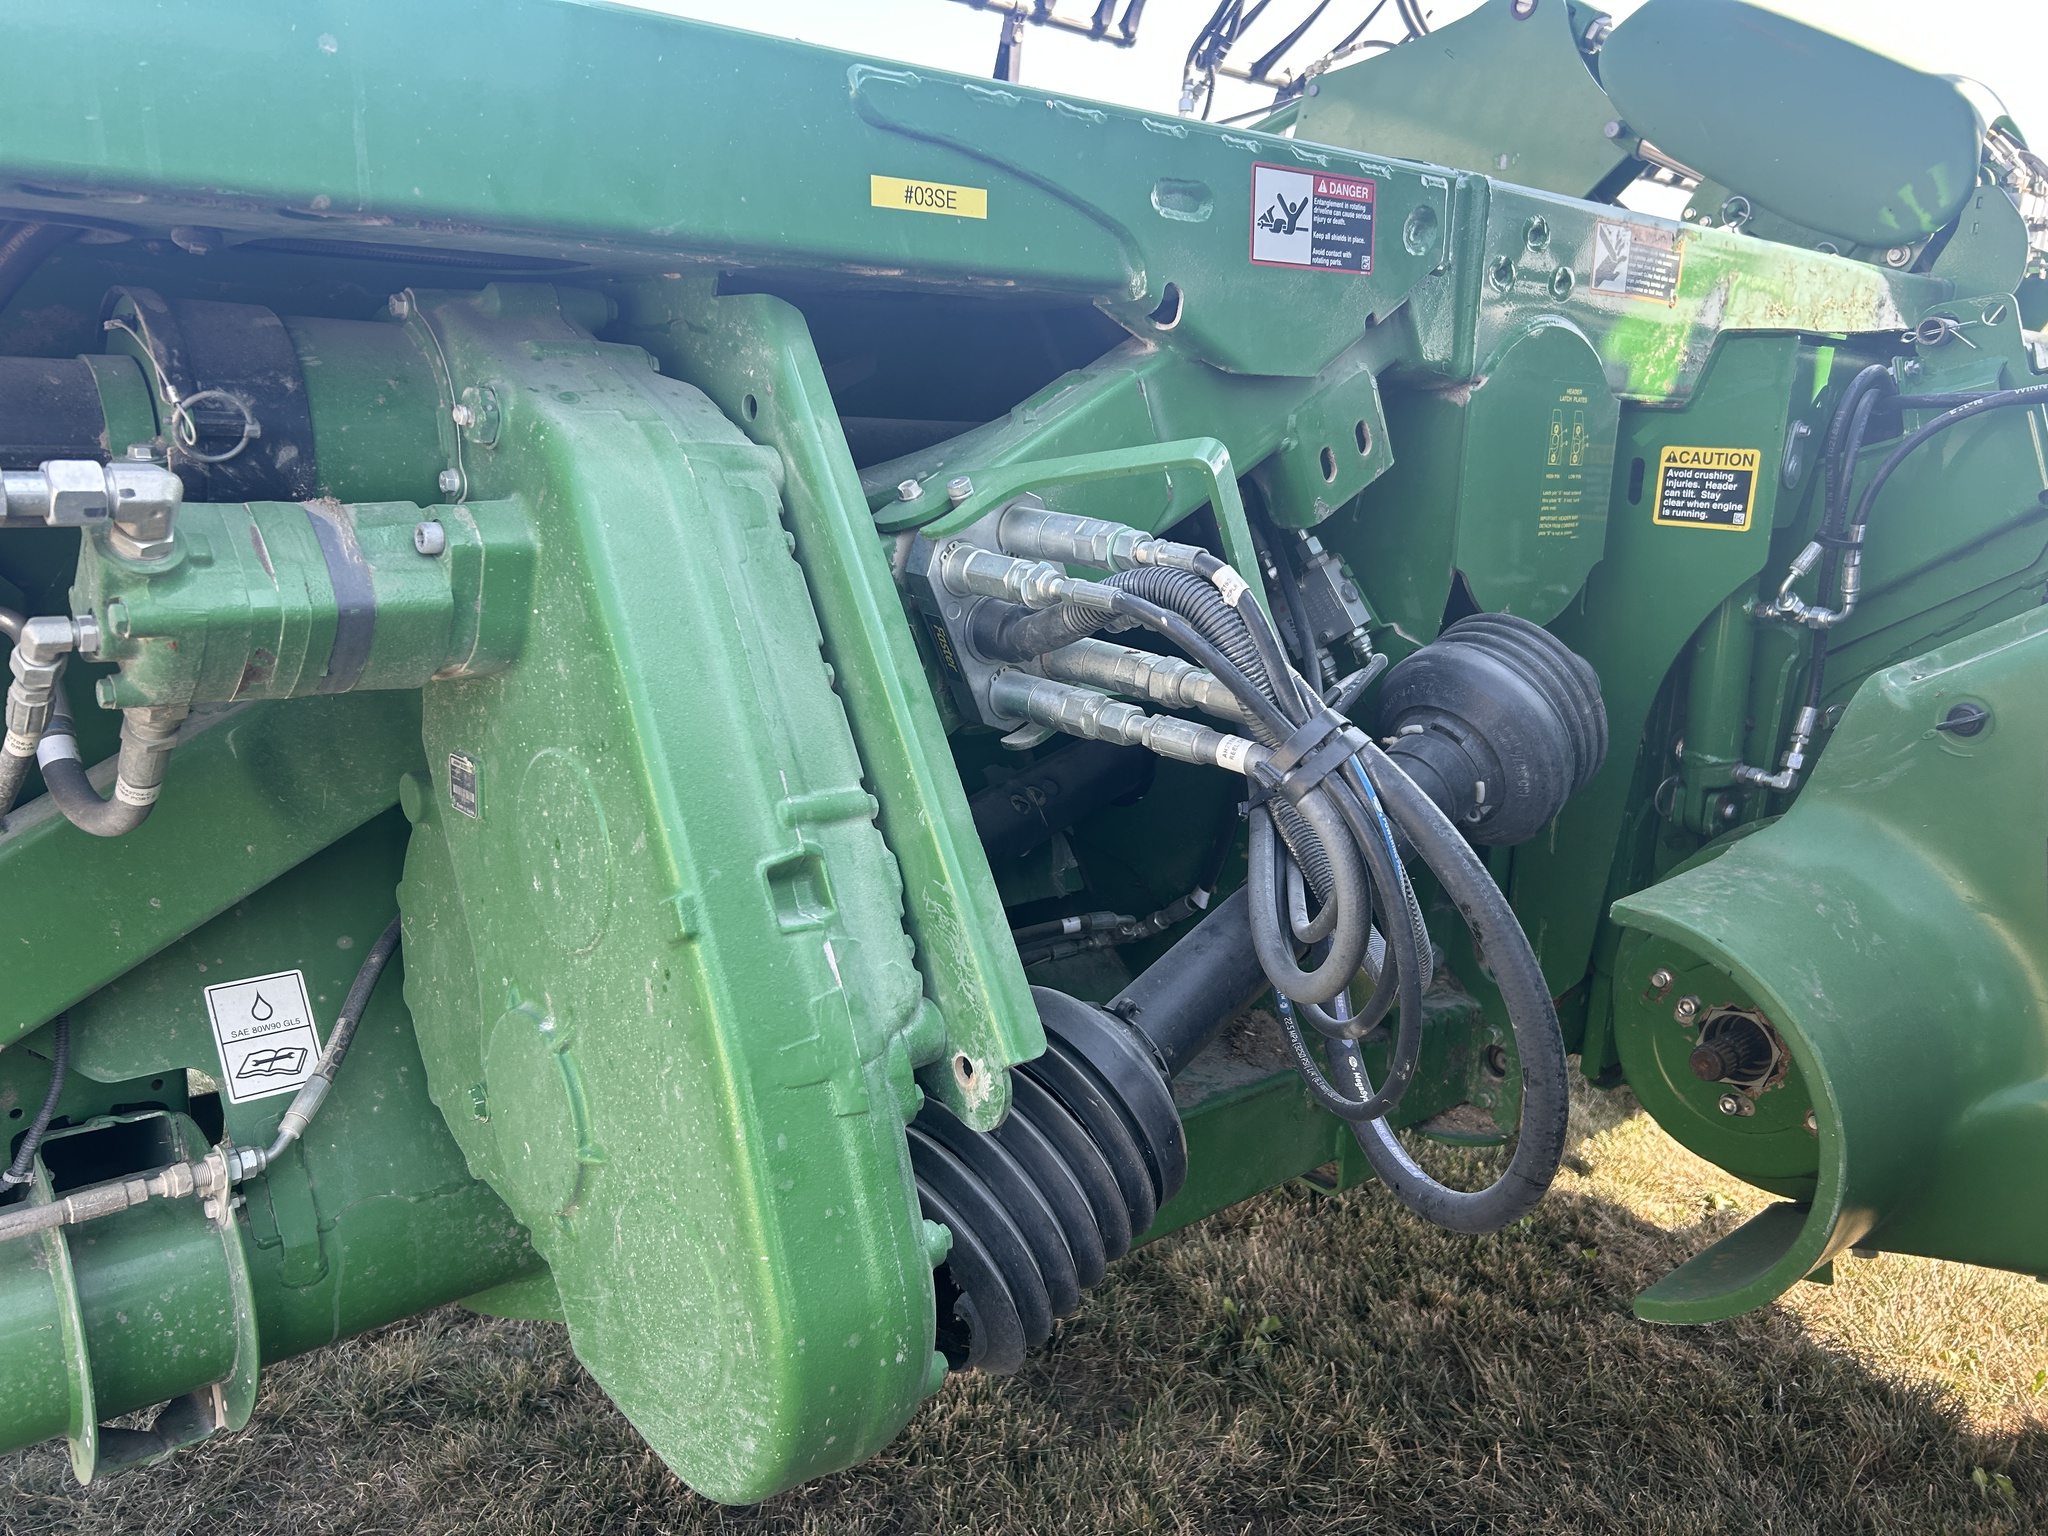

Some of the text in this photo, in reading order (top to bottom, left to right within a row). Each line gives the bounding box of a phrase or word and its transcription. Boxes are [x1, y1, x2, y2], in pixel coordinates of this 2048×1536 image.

[904, 185, 957, 209] #03SE
[1329, 182, 1369, 199] DANGER
[1314, 197, 1344, 209] Entanglement
[1350, 203, 1366, 213] rotating
[1314, 206, 1332, 215] driveline
[1342, 211, 1355, 219] cause
[1356, 212, 1371, 220] serious
[1313, 216, 1326, 224] injury
[1332, 217, 1346, 225] death.
[1313, 231, 1324, 240] Keep
[1331, 233, 1347, 242] shields
[1352, 236, 1365, 244] place.
[1312, 248, 1325, 256] Avoid
[1312, 256, 1329, 266] rotating
[1679, 451, 1755, 467] CAUTION
[1667, 469, 1734, 482] Avoid crushing
[1666, 479, 1738, 491] injuries. Header
[1682, 489, 1696, 498] tilt.
[1700, 490, 1721, 501] Stay
[1663, 498, 1743, 512] clear when engine
[1662, 507, 1708, 520] is running.
[1382, 817, 1398, 858] POWERING
[231, 1018, 301, 1038] SAE 80W90 GL5
[1353, 1072, 1369, 1102] MegaSy
